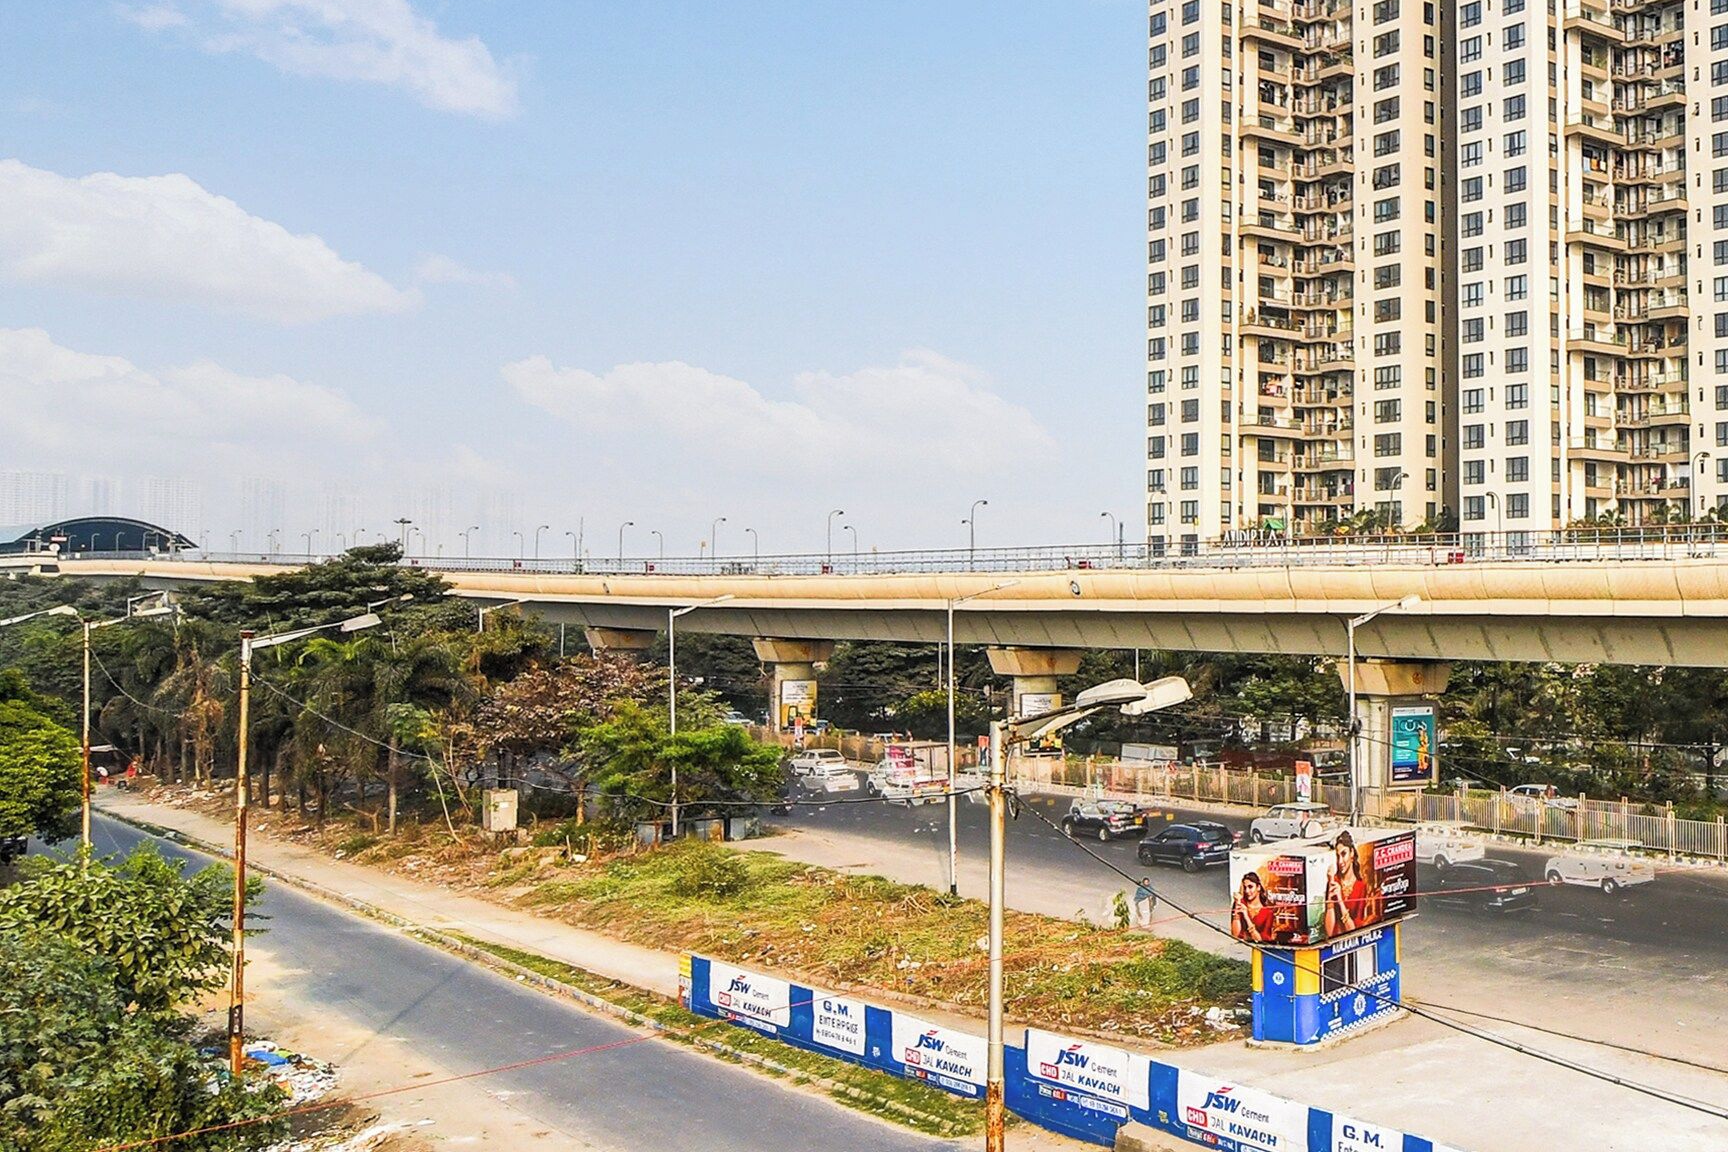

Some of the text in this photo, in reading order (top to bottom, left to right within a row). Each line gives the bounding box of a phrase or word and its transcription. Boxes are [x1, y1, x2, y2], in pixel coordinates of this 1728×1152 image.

[728, 979, 751, 994] JSW
[743, 1002, 772, 1018] KAVACH
[914, 1034, 945, 1052] JSW
[936, 1059, 972, 1077] KAVACH
[1054, 1049, 1118, 1078] JSW Cement
[1078, 1075, 1121, 1095] KAVACH
[1200, 1092, 1270, 1123] JSW Cement
[1229, 1122, 1278, 1146] KAVACH
